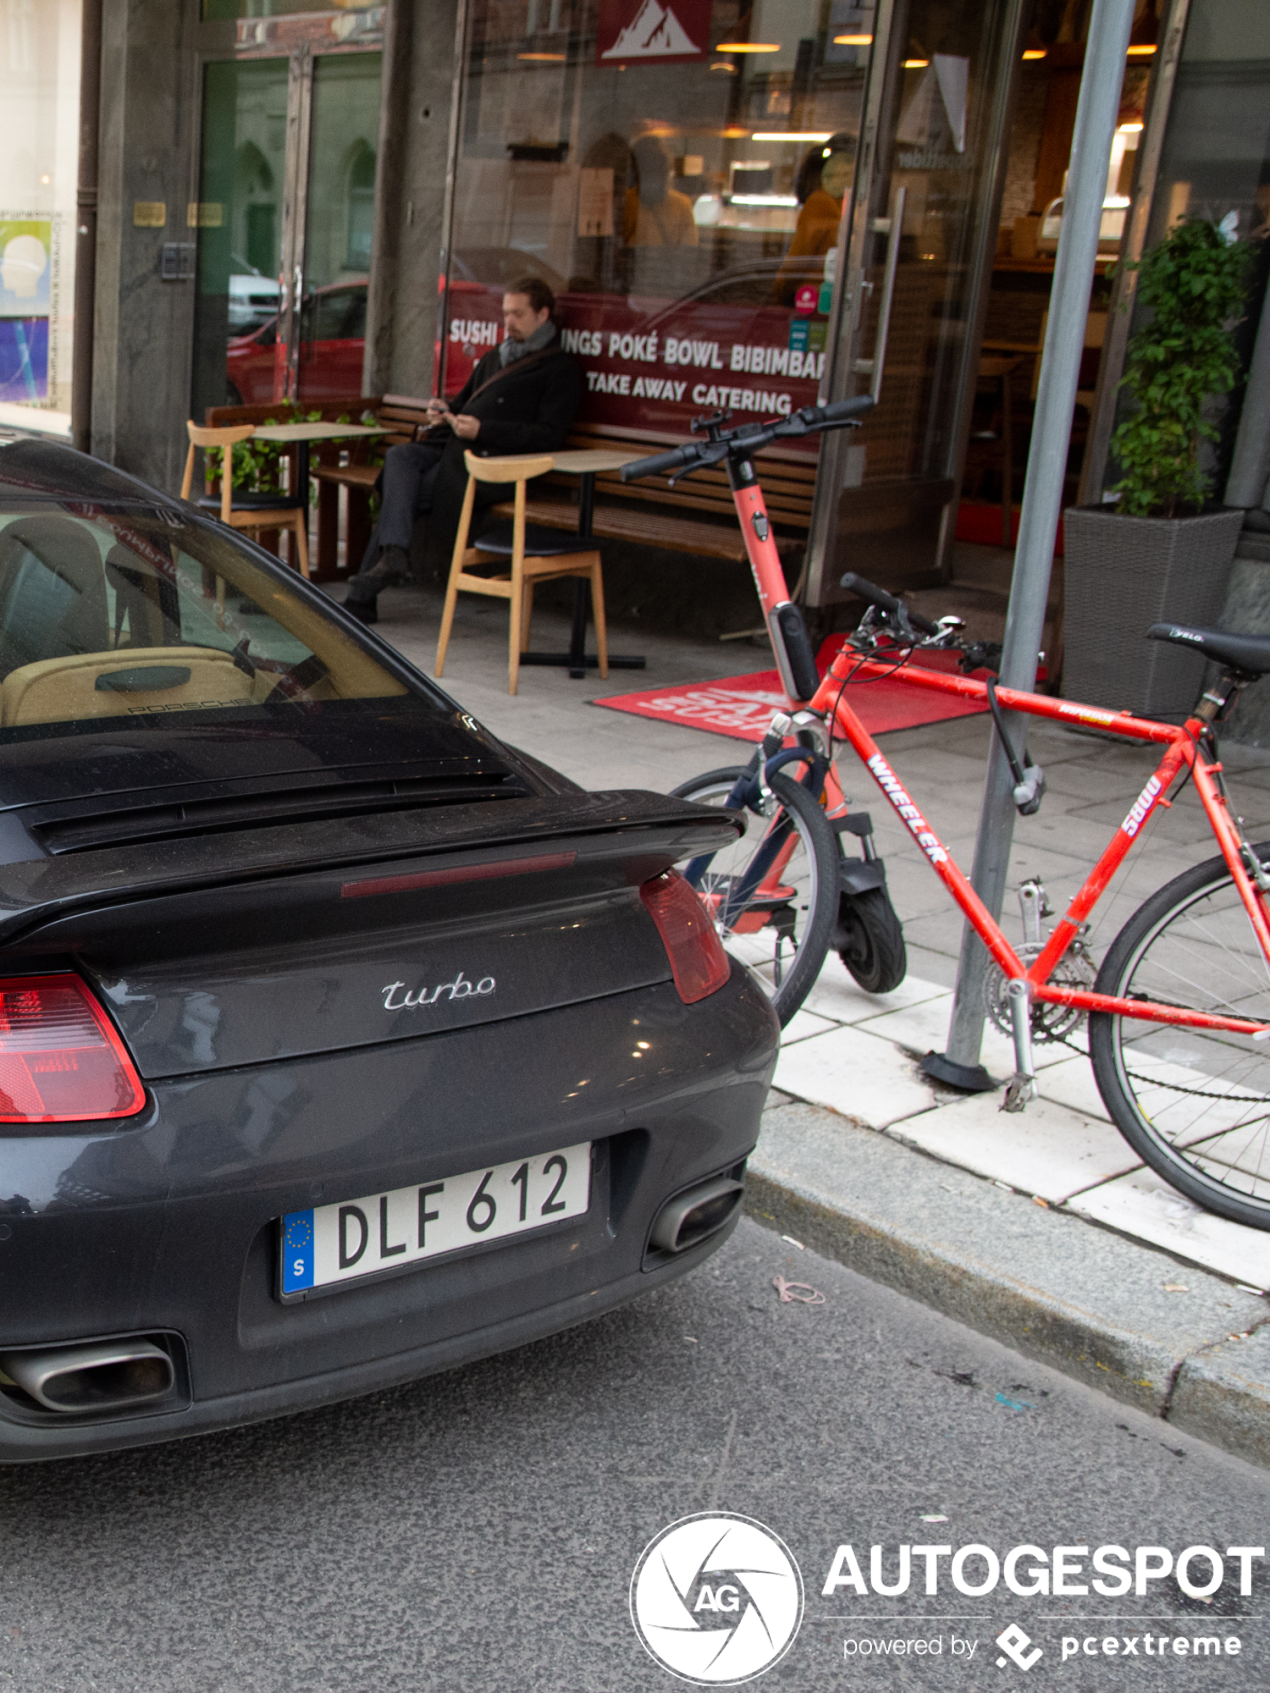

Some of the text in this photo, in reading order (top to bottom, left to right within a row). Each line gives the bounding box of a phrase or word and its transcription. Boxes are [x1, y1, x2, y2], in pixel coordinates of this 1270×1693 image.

[450, 319, 498, 346] SUSHI
[608, 330, 658, 362] POKÉ
[664, 337, 723, 370] BOWL
[587, 371, 792, 415] TAKE AWAY CATERING
[128, 698, 250, 714] PORSCHE
[867, 753, 948, 863] WHEELER
[1121, 775, 1162, 837] 5800
[339, 1155, 568, 1270] DLF 612
[293, 1259, 305, 1276] S
